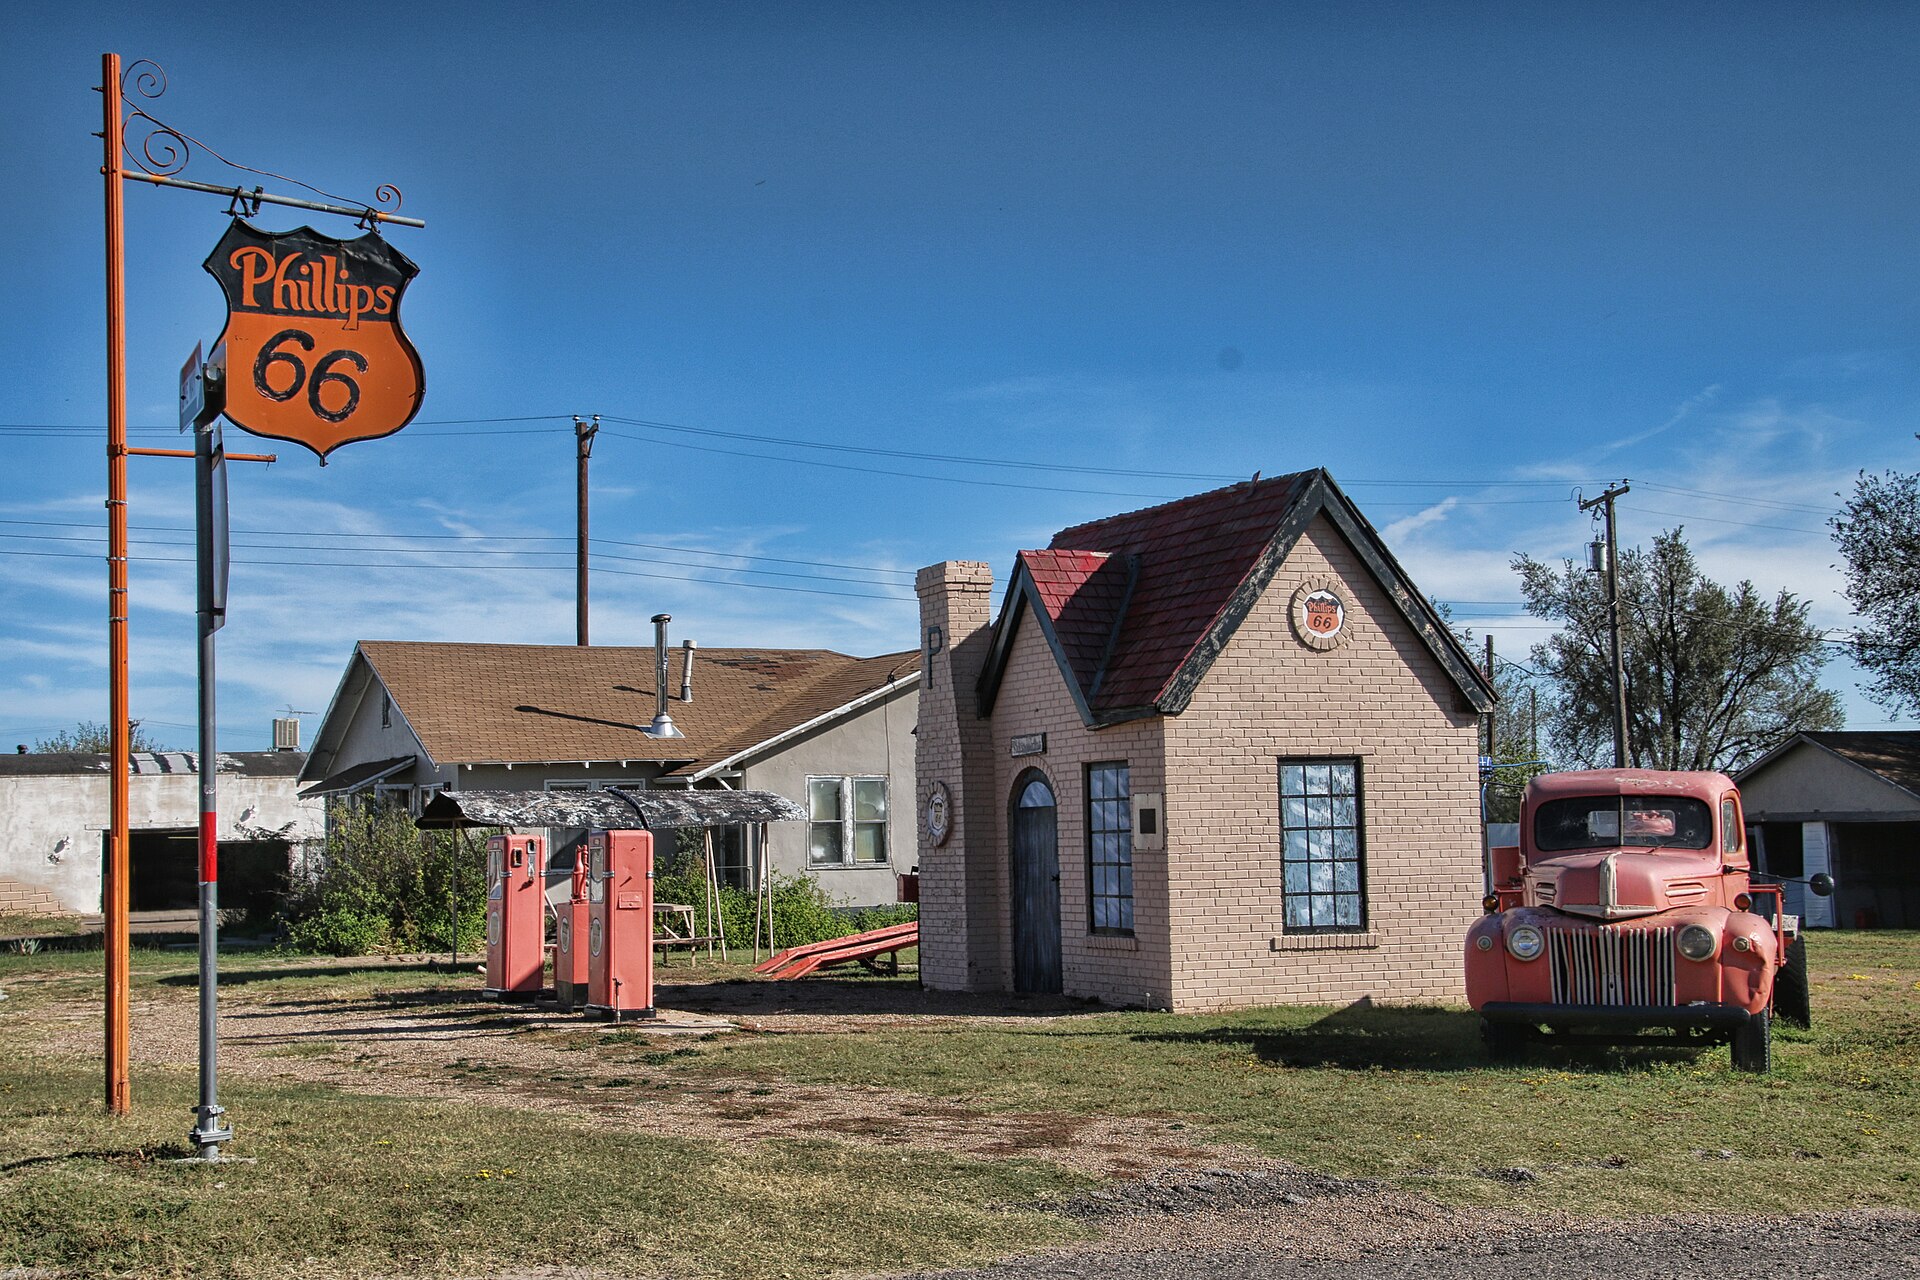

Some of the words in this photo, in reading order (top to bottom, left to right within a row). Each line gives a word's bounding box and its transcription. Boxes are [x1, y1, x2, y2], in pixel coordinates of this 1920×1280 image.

[230, 246, 396, 330] Phillips
[253, 328, 369, 423] 66
[1306, 601, 1336, 614] Phillips
[1313, 615, 1332, 629] 66
[927, 625, 942, 690] P
